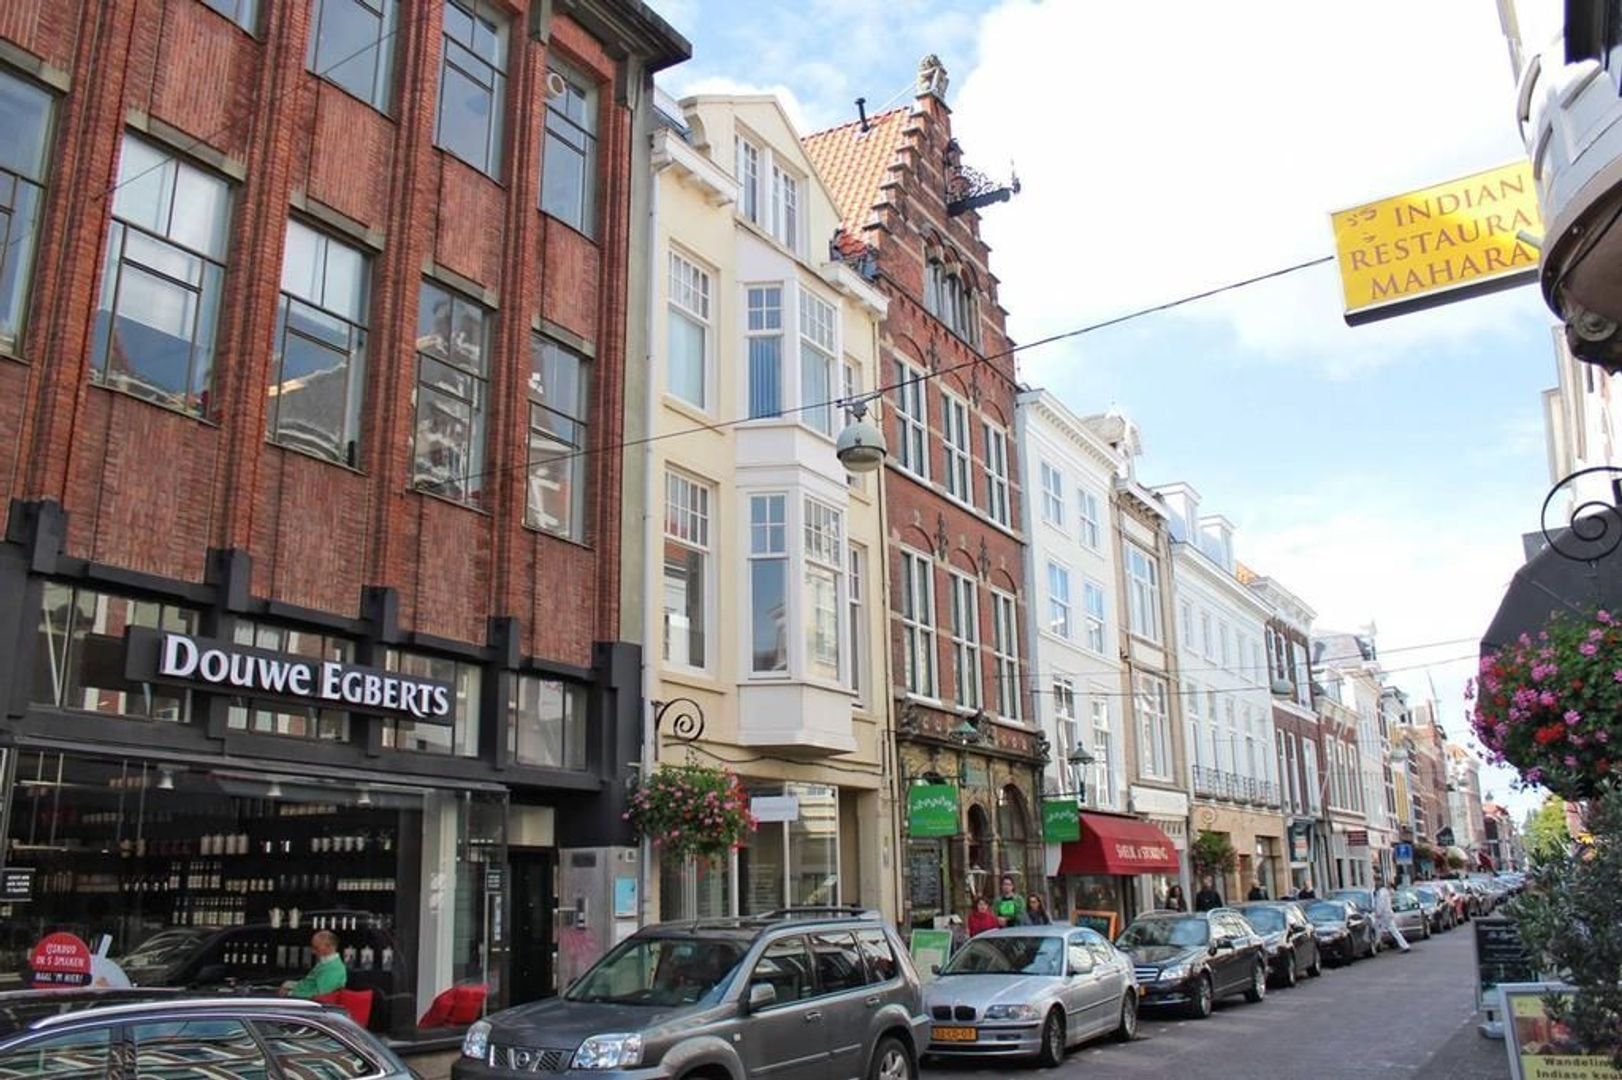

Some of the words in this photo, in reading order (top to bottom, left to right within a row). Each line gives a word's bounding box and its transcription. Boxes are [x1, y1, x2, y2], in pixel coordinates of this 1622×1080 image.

[1394, 175, 1525, 227] INDIAN
[1350, 208, 1534, 271] RESTAURA
[1372, 241, 1533, 300] MAHARA
